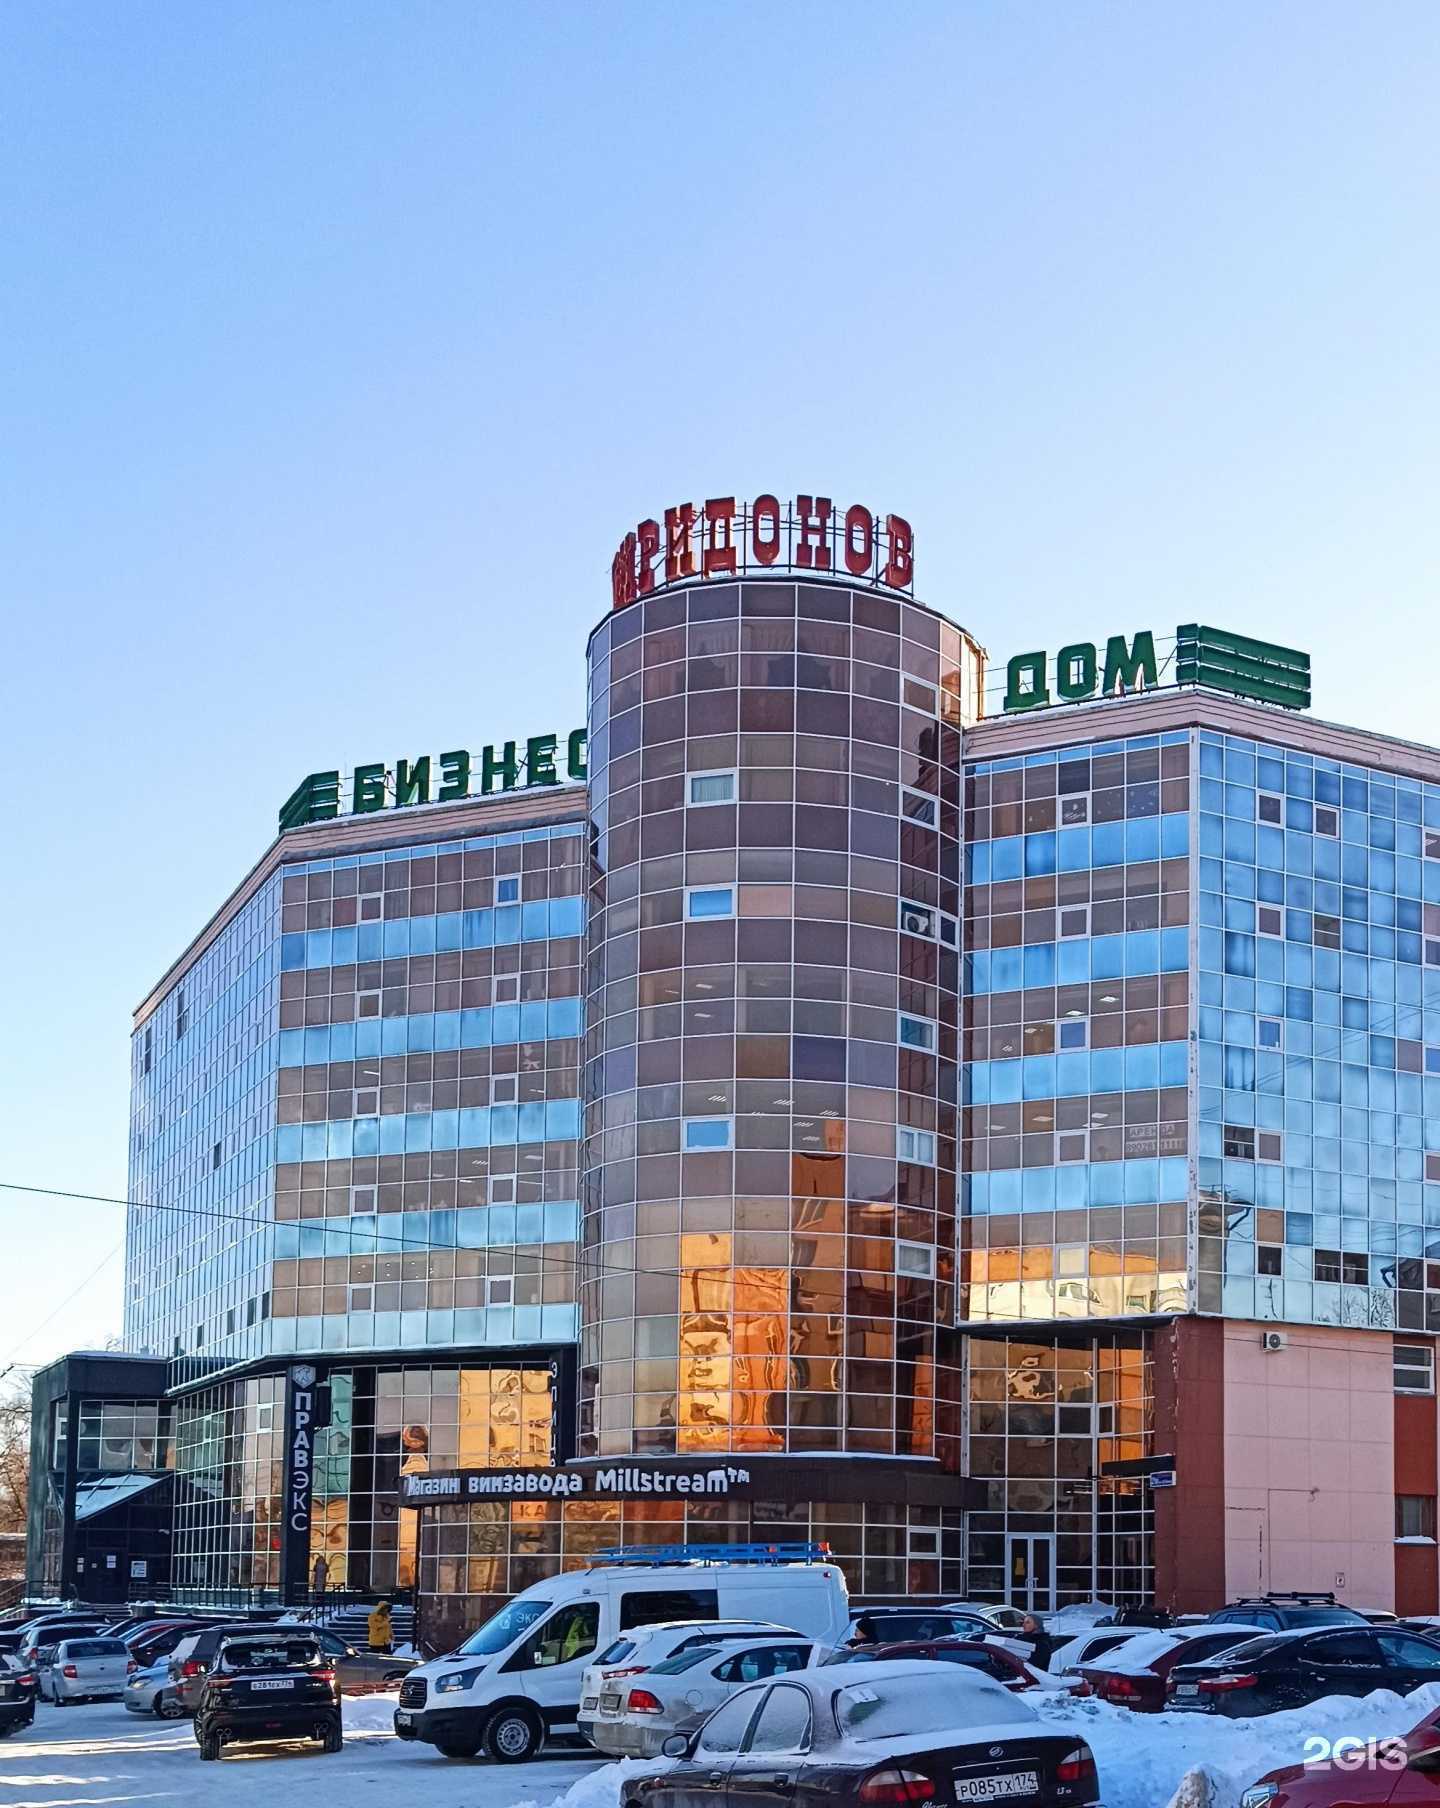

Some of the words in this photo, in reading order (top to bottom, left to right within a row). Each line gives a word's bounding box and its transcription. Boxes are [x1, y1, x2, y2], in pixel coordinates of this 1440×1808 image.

[1003, 630, 1158, 712] ДОМ
[291, 1392, 312, 1531] ПРАВЭКС
[469, 1473, 582, 1496] винзавода
